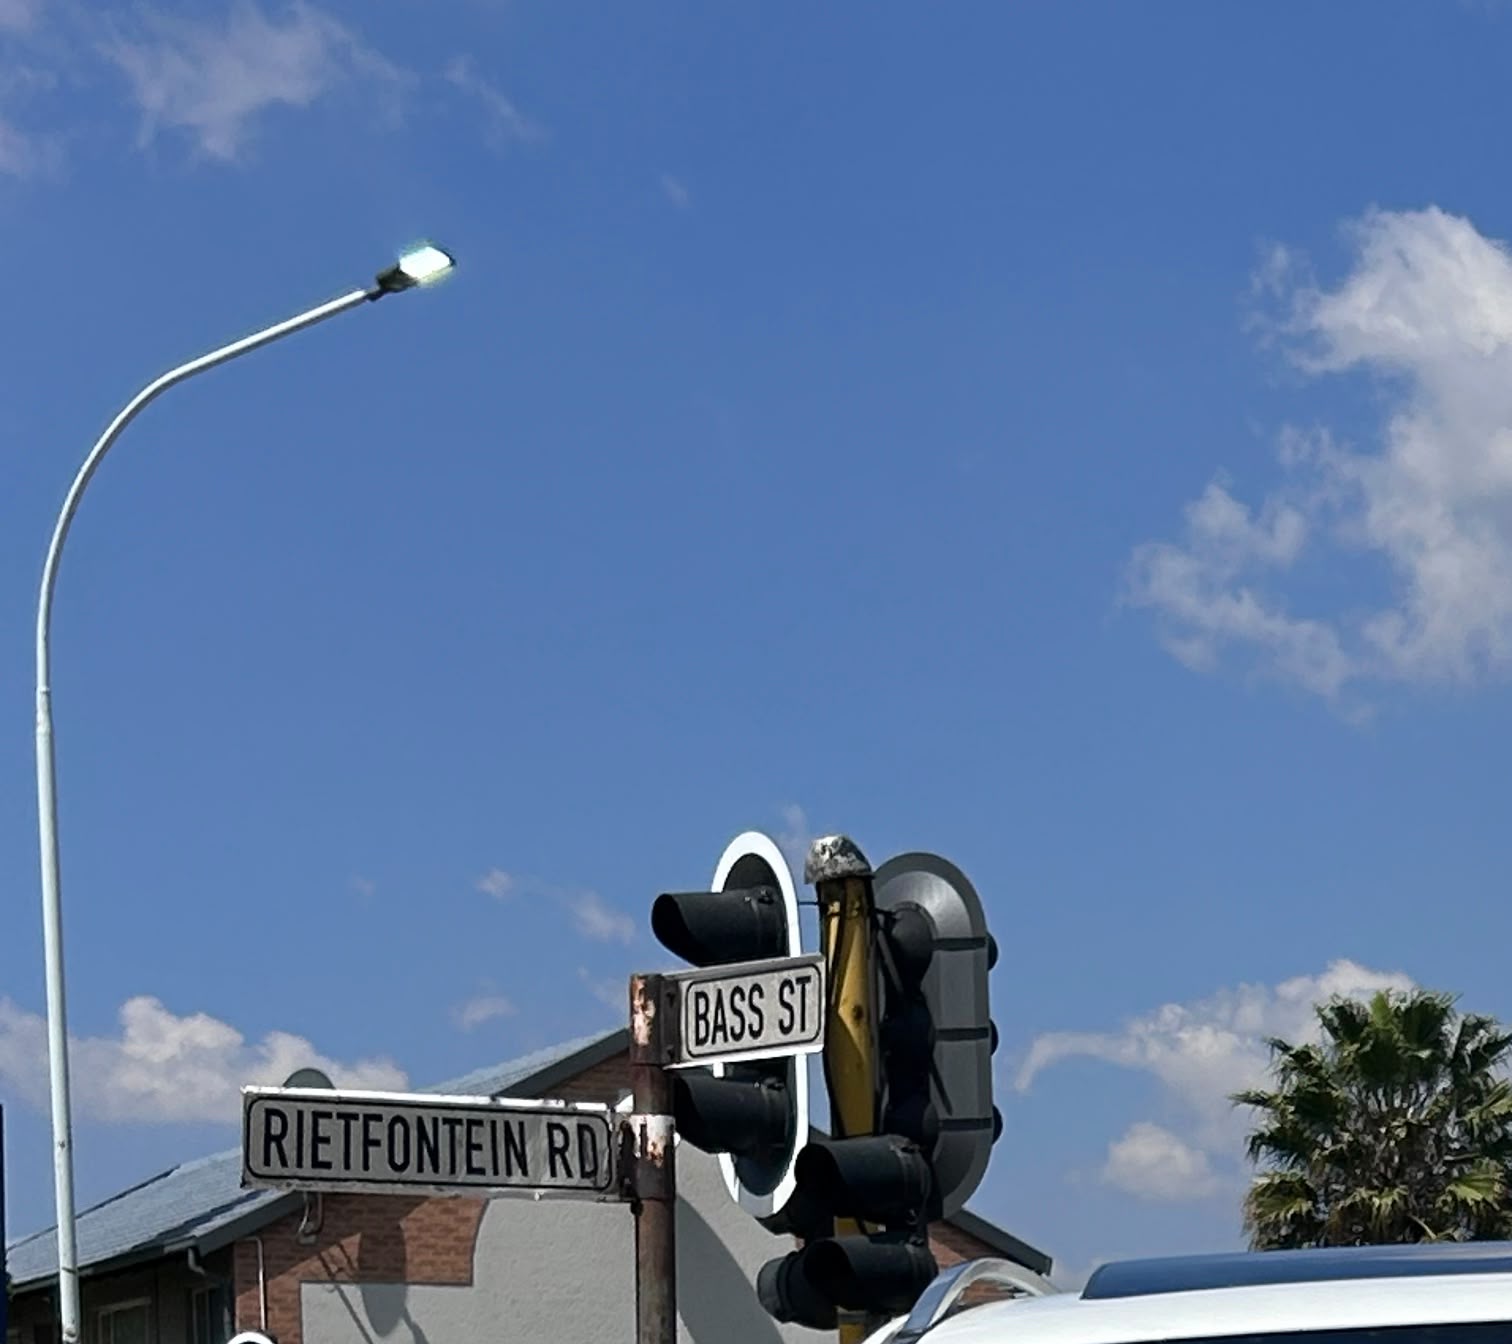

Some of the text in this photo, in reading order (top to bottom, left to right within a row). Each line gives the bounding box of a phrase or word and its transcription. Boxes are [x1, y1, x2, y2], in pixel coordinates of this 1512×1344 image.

[694, 975, 813, 1048] BASS ST
[262, 1106, 600, 1180] RIETFONTEIN RD
